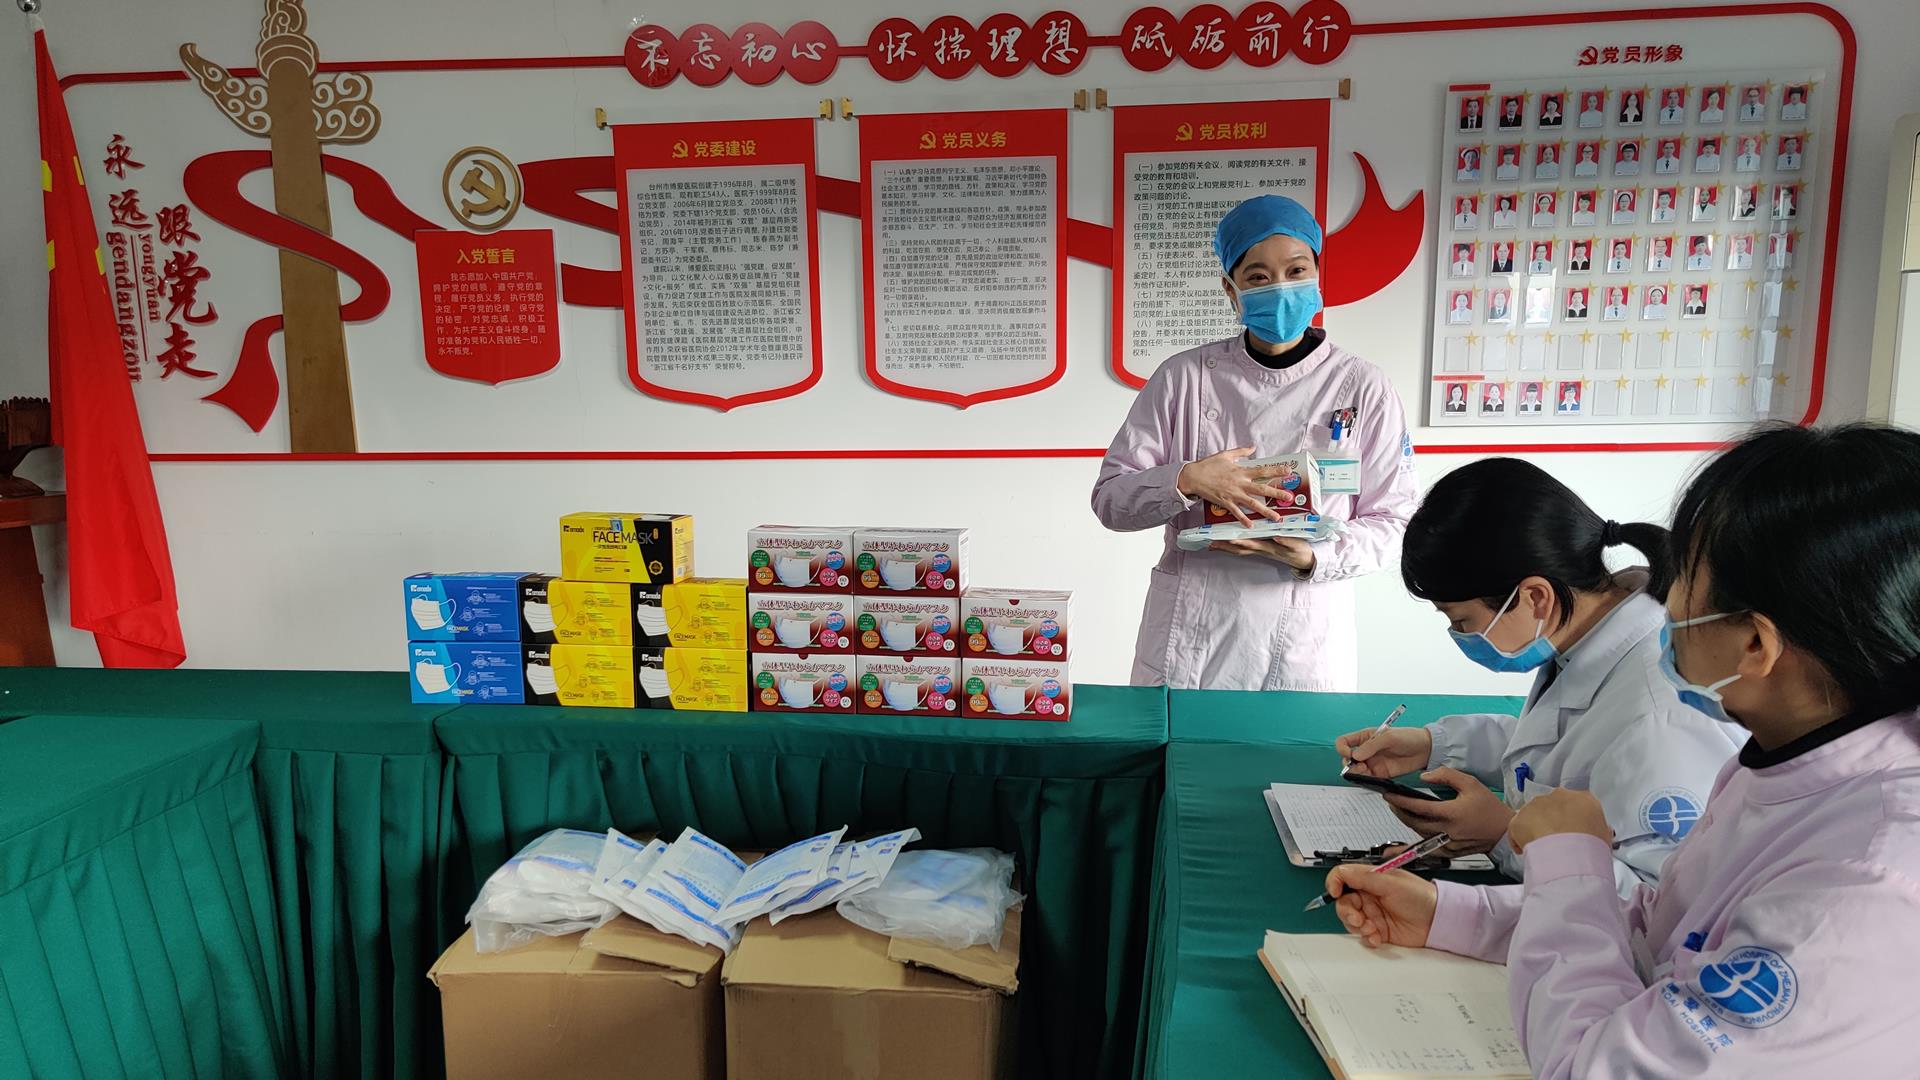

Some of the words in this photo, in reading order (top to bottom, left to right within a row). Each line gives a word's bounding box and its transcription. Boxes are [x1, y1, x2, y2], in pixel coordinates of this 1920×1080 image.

[637, 31, 826, 77] 不忘初心
[879, 19, 1079, 65] 怀揣理想
[1131, 13, 1339, 59] 砥砺前行
[1601, 44, 1683, 63] 党员形象
[943, 131, 1008, 149] 党员义务
[1200, 122, 1266, 140] 党员权利
[694, 140, 756, 158] 党委建设
[457, 248, 515, 264] 入党誓言
[138, 233, 161, 323] yongyuan
[1680, 1011, 1719, 1054] HOSPITAL
